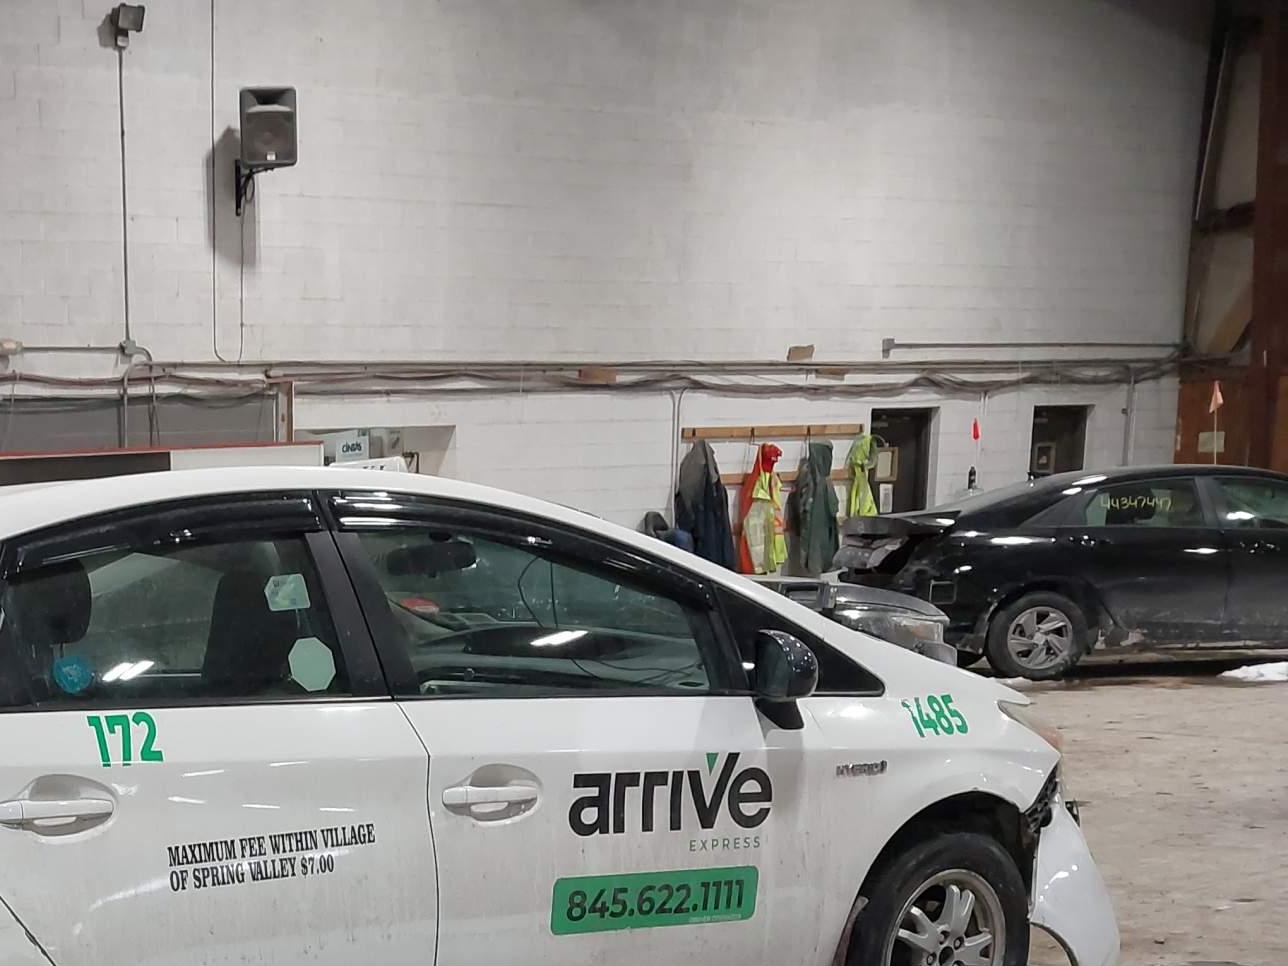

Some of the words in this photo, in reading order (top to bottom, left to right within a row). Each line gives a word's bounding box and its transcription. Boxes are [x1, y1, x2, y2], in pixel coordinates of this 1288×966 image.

[900, 694, 969, 738] 1485
[86, 711, 164, 767] 172
[167, 839, 236, 867] MAXIMUM
[239, 836, 267, 859] FEE
[269, 829, 319, 855] WITHIN
[320, 823, 376, 849] VILLAGE
[689, 836, 761, 852] EXPRESS
[169, 870, 189, 892] OF
[192, 863, 246, 889] SPRING
[248, 857, 297, 882] VALLEY
[300, 854, 335, 879] $7.00
[566, 879, 745, 922] 845.622.1111
